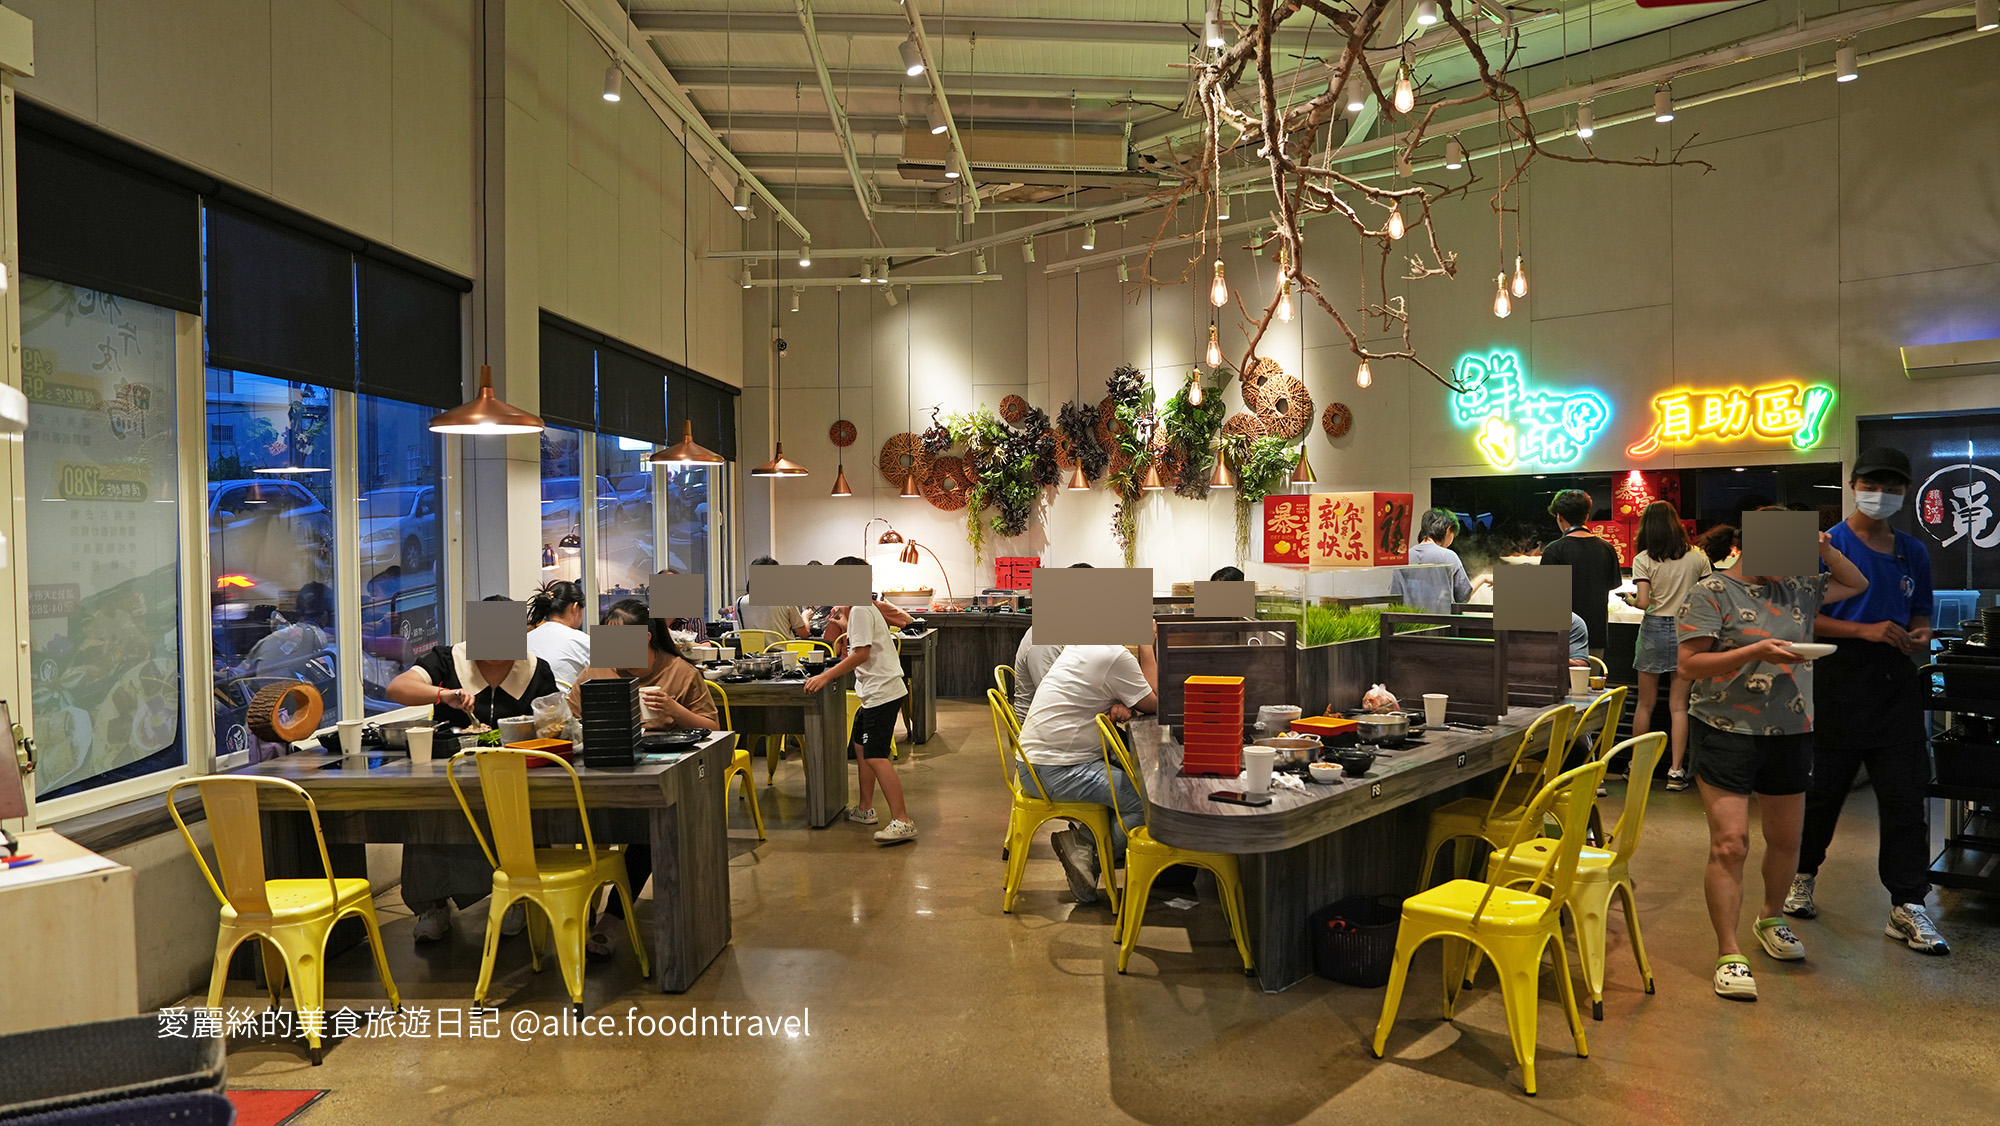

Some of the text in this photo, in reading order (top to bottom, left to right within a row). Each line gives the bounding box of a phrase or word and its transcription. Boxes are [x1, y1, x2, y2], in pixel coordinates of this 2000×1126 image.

[1318, 498, 1363, 534] 新年
[1317, 531, 1369, 562] 快乐
[1458, 754, 1465, 766] F7
